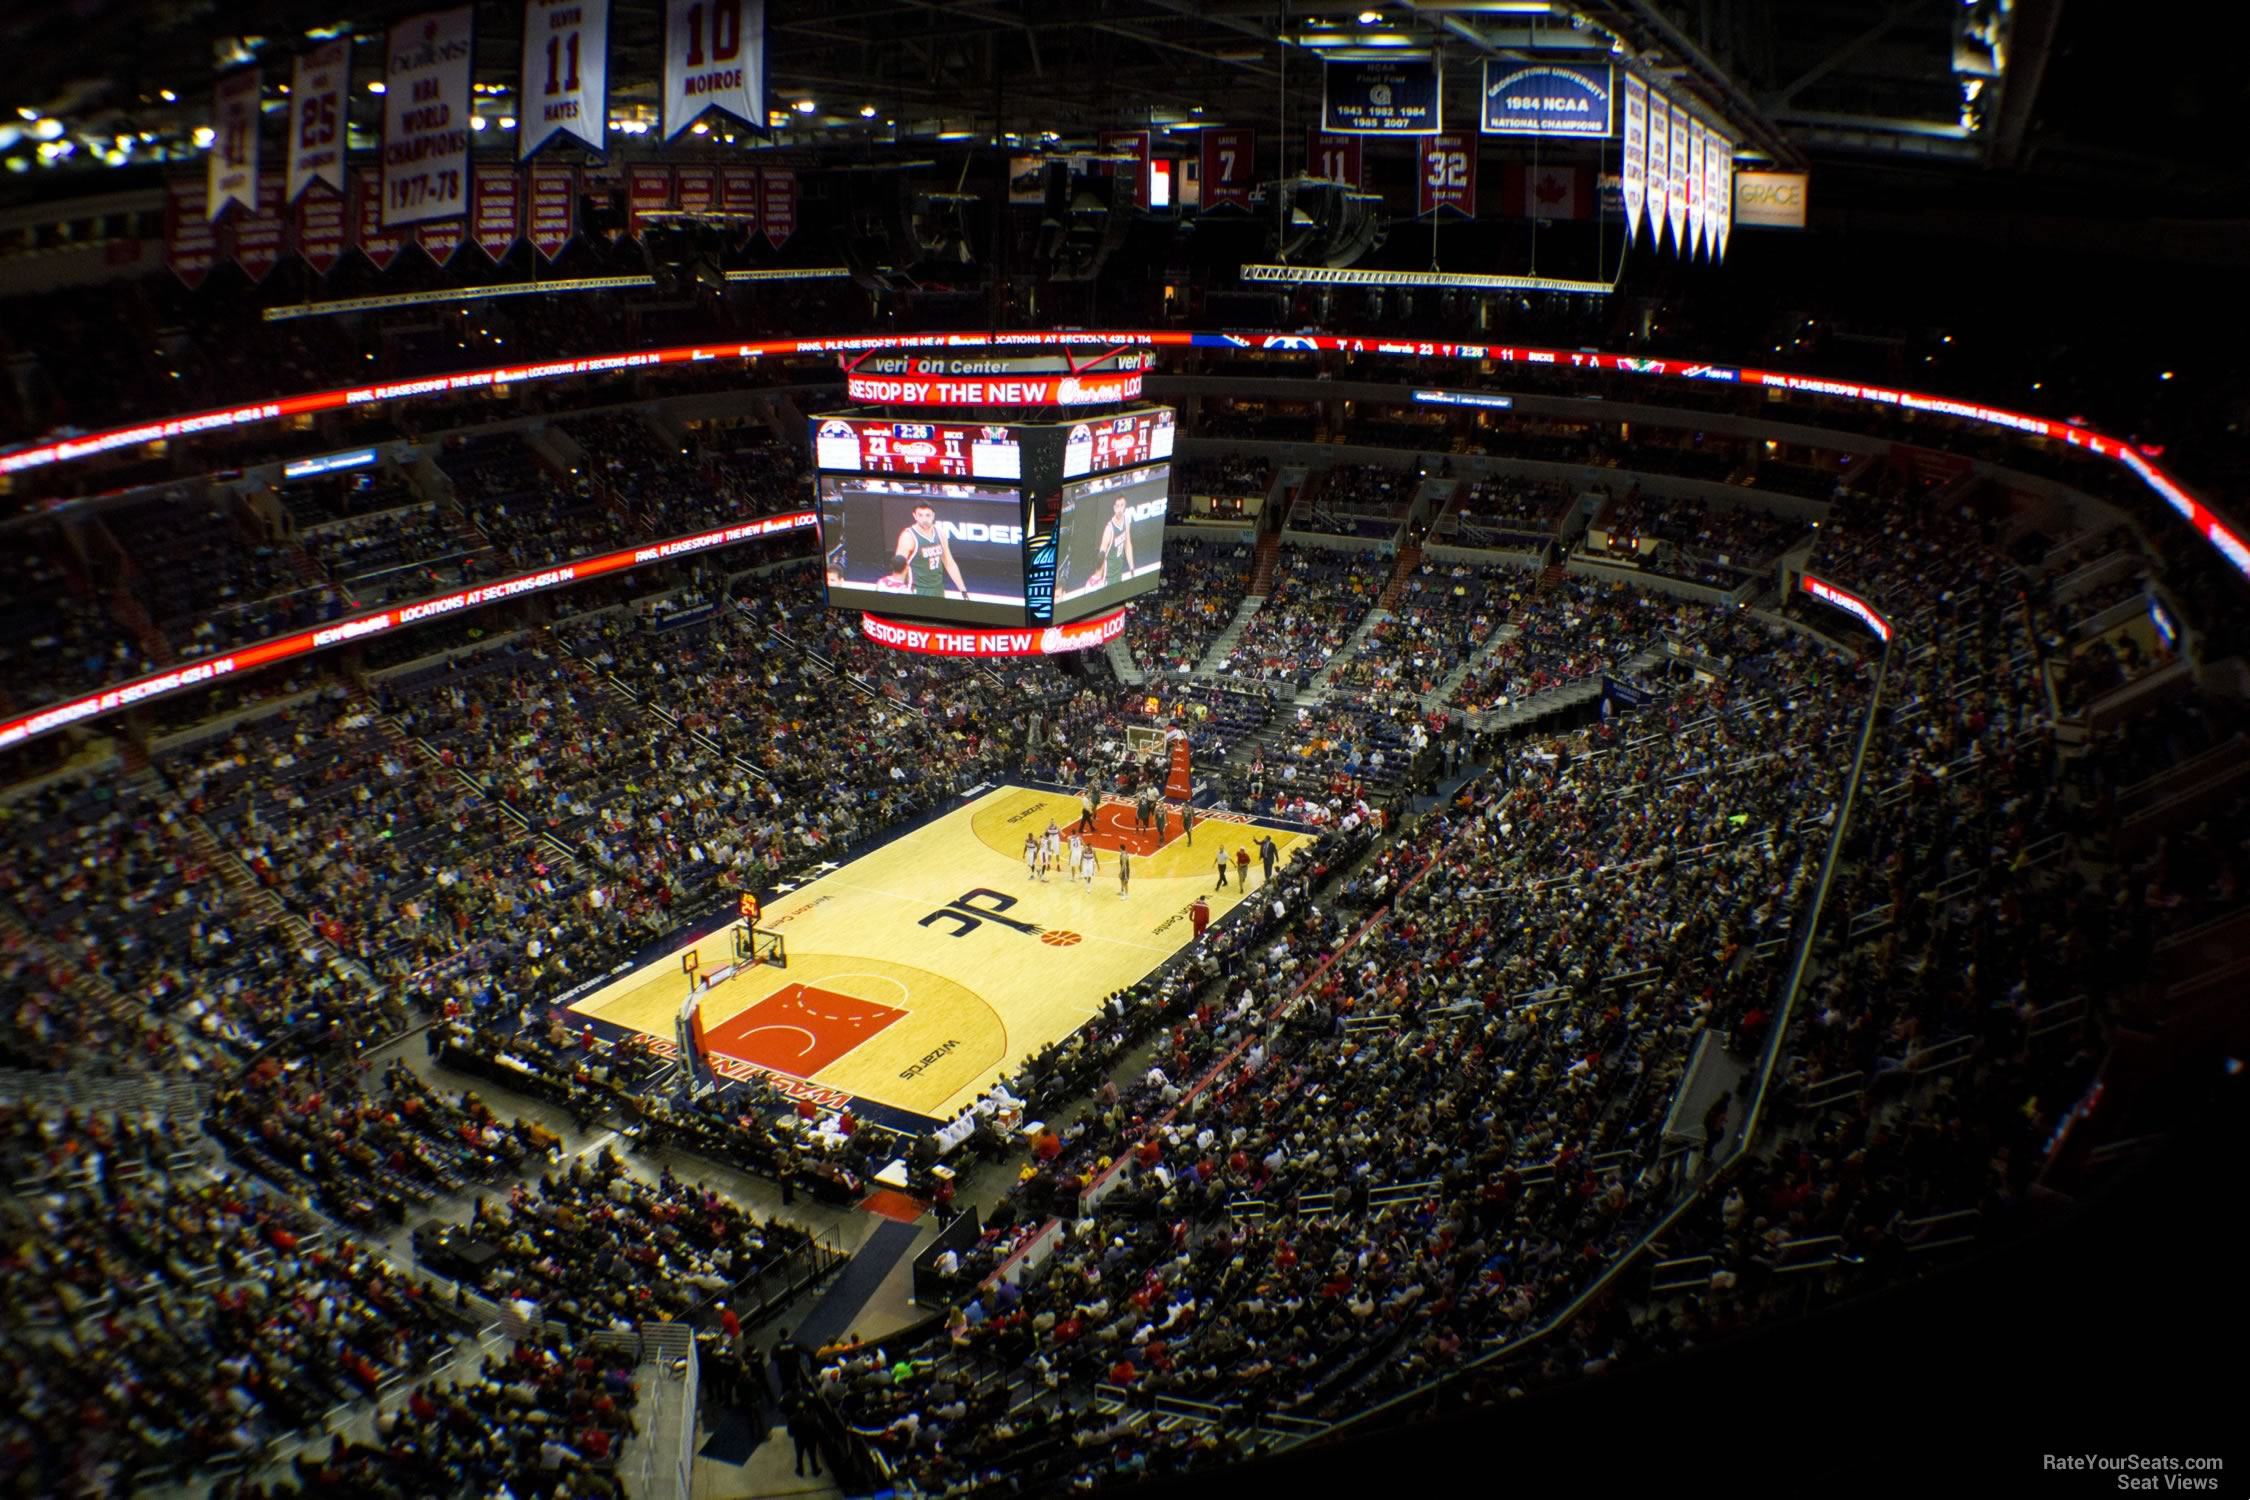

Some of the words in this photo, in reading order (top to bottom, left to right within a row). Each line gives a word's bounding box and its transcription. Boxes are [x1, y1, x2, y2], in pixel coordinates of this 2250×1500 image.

[687, 1, 741, 67] 10
[544, 32, 580, 95] 11
[685, 70, 742, 96] MONROE
[1488, 66, 1549, 97] GEORGETOWN
[1551, 66, 1607, 101] UNIVERSITY
[544, 101, 579, 121] HAYES
[1337, 105, 1362, 116] 1943
[1369, 106, 1394, 117] 1982
[1400, 106, 1425, 117] 1984
[1506, 97, 1540, 111] 1984
[1543, 97, 1590, 112] NCAA
[303, 92, 337, 149] 25
[403, 104, 450, 134] WORLD
[1384, 118, 1409, 128] 2007
[1490, 118, 1539, 130] NATIONAL
[1541, 119, 1603, 131] CHAMPIONS
[386, 130, 466, 166] CHAMPIONS
[1219, 150, 1235, 182] 7
[1322, 151, 1346, 185] 11
[1427, 151, 1468, 188] 32
[391, 169, 459, 209] 1977-78
[1740, 183, 1800, 205] GRACE
[899, 336, 919, 347] THE
[920, 335, 945, 346] NEW
[1044, 334, 1057, 344] AT
[1059, 334, 1107, 345] SECTIONS
[1420, 343, 1434, 355] 23
[1501, 349, 1514, 361] 11
[528, 364, 574, 379] LOCATIONS
[576, 362, 589, 372] AT
[877, 354, 944, 377] verizon
[951, 360, 1010, 374] Center
[865, 380, 901, 402] STOP
[902, 382, 930, 403] BY
[937, 383, 984, 403] THE
[988, 383, 1047, 403] NEW
[901, 424, 928, 439] 2:26
[869, 438, 886, 454] 23
[945, 440, 961, 457] 11
[660, 540, 692, 557] PLEASE
[725, 527, 742, 542] THE
[741, 523, 762, 538] NEW
[400, 596, 464, 623] LOCATIONS
[466, 590, 484, 605] AT
[482, 578, 535, 600] SECTIONS
[876, 622, 905, 645] STOP
[907, 630, 930, 650] BY
[935, 634, 976, 652] THE
[980, 634, 1033, 652] NEW
[1008, 802, 1048, 825] wizards
[741, 901, 755, 915] 24
[899, 1039, 961, 1081] wizards
